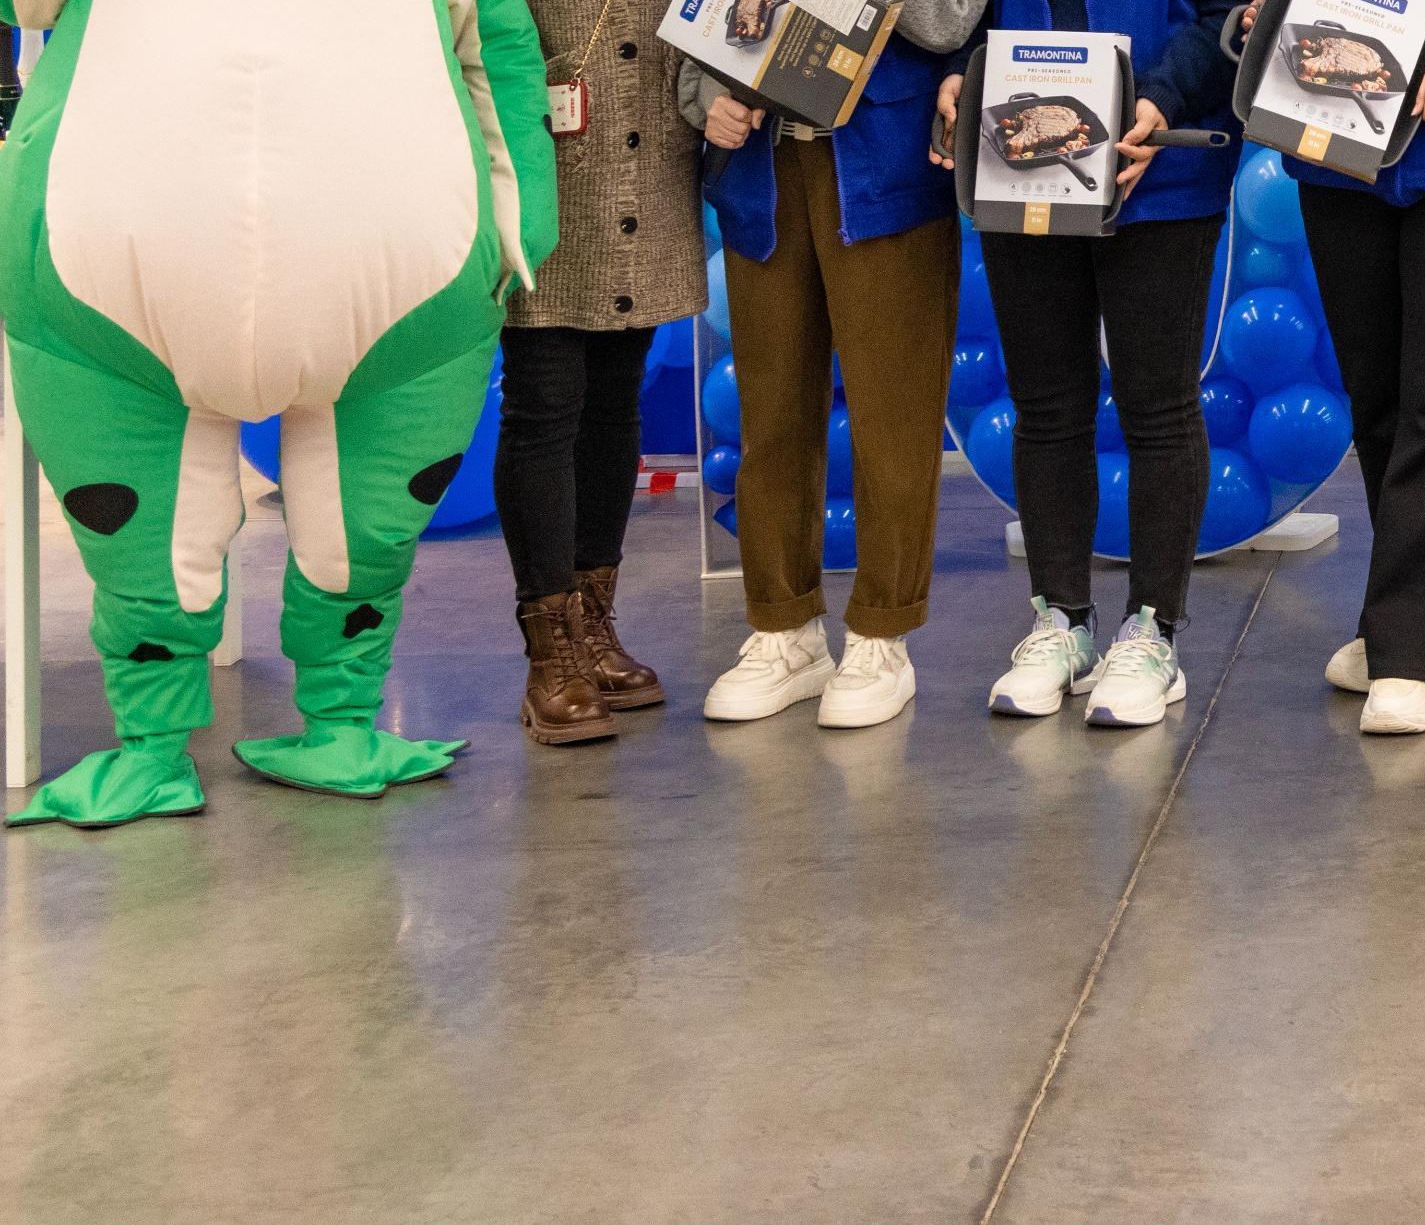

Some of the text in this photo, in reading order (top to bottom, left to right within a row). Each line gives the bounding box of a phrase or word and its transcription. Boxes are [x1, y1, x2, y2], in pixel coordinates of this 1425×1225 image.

[1018, 49, 1083, 61] TRAMONTINA
[1004, 75, 1028, 83] CAST
[1075, 77, 1093, 85] PAN
